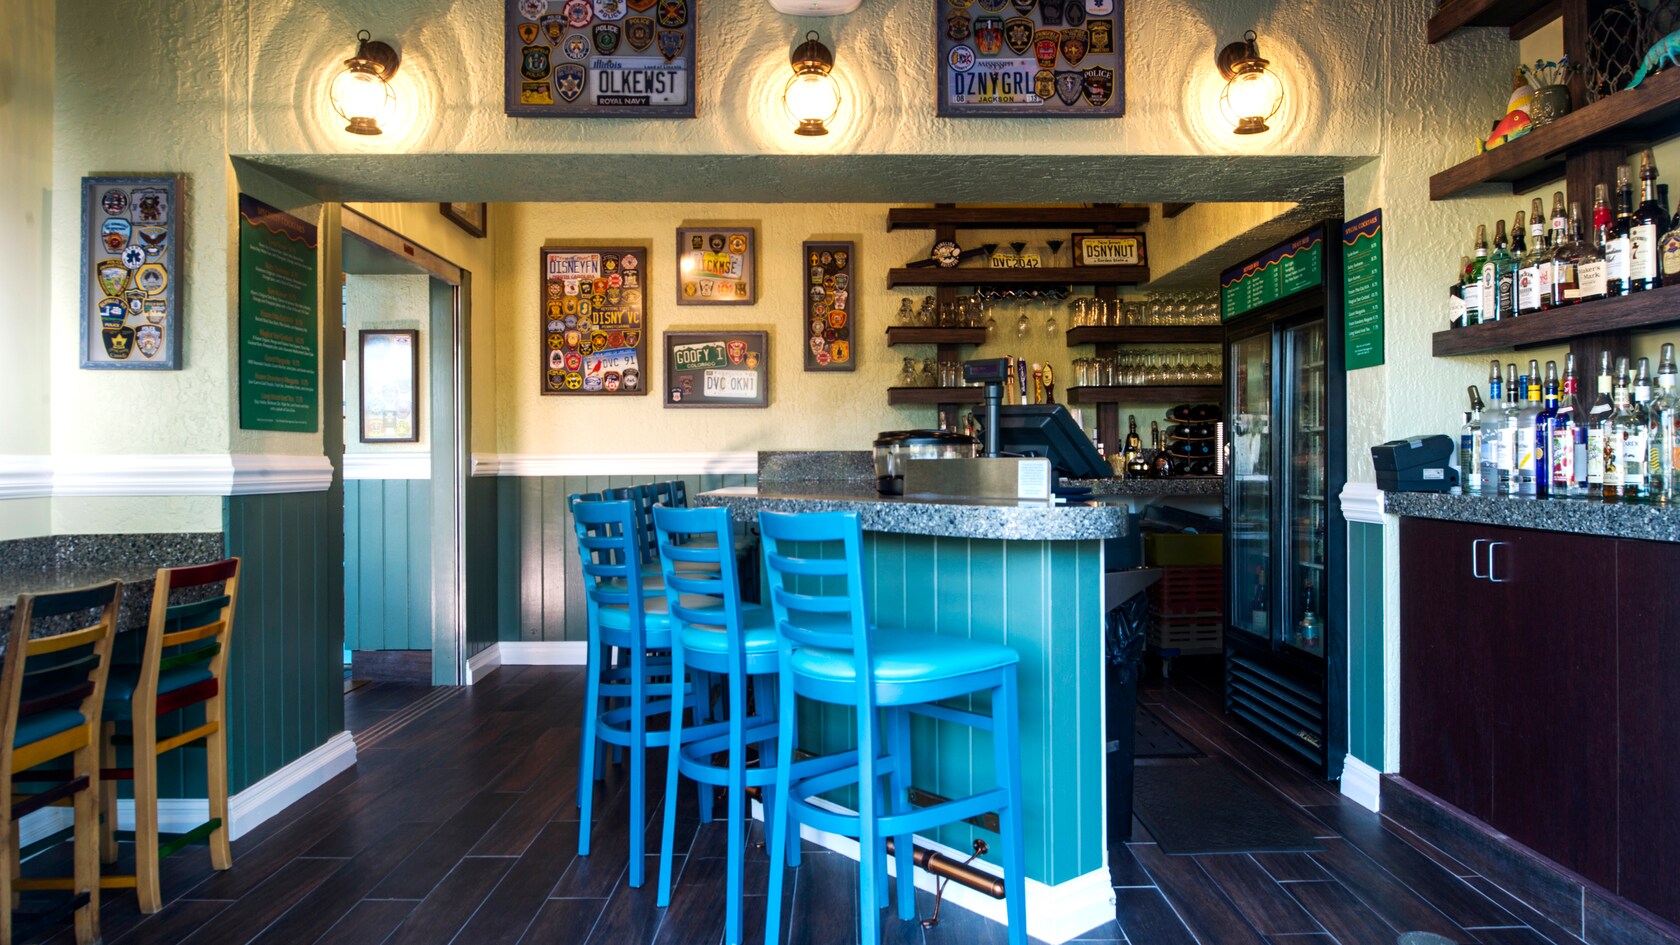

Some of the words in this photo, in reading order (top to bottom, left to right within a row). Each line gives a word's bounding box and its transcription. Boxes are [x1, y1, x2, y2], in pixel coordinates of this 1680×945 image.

[595, 24, 619, 34] POLICE
[593, 59, 622, 69] Illinois
[1084, 70, 1112, 79] POLICE
[599, 70, 678, 94] OLKEWST
[955, 71, 1035, 95] DZNYGRL
[599, 97, 622, 105] ROYAL
[624, 97, 646, 105] NAVY
[1086, 245, 1134, 257] DSNYNUT
[550, 261, 598, 273] DISNEYFN
[593, 312, 623, 325] DISNY
[628, 312, 640, 324] VC
[677, 349, 710, 364] GOOFY
[687, 361, 716, 369] COLORADO
[707, 377, 726, 390] DVC
